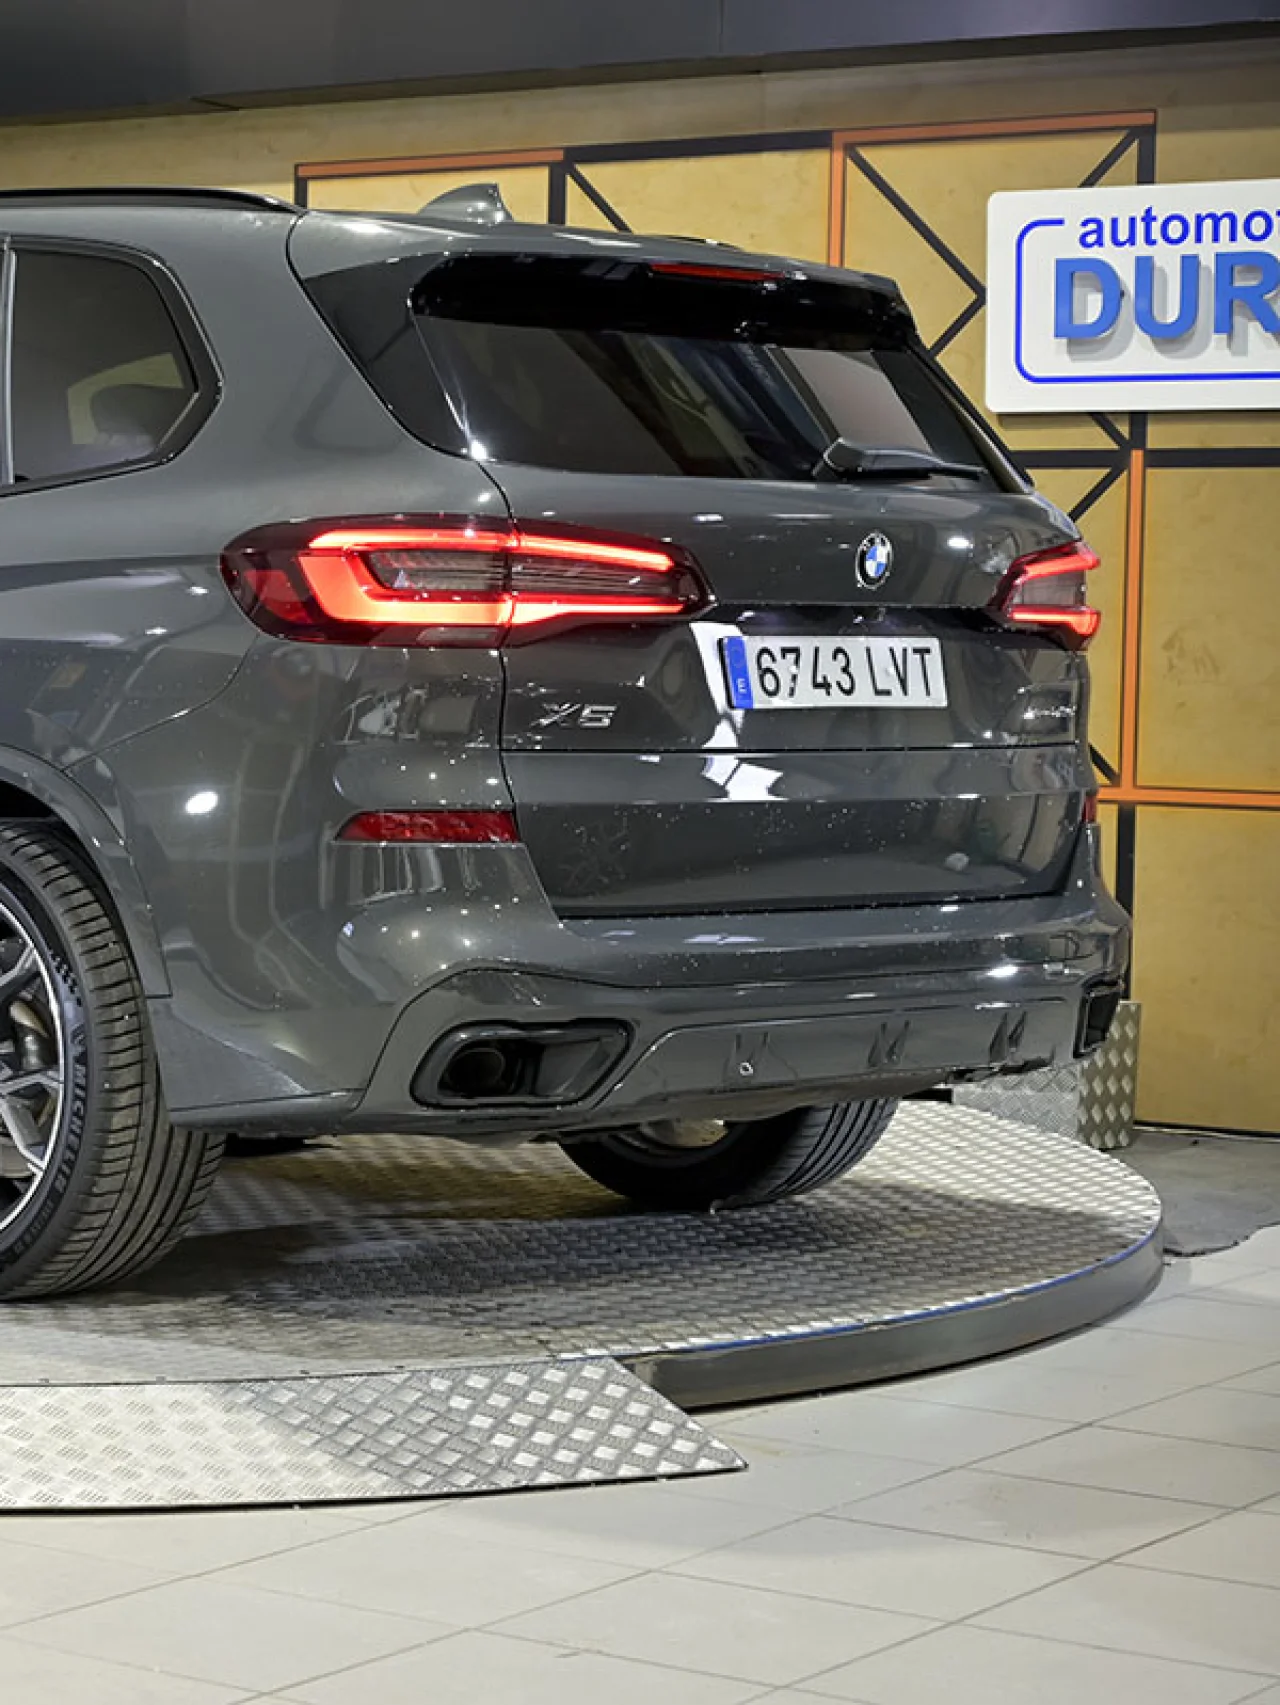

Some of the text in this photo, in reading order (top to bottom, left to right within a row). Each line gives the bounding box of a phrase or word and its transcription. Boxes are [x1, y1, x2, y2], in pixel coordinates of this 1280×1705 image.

[1078, 205, 1280, 249] automo
[756, 645, 932, 698] 6743 LVT
[529, 702, 617, 729] X5
